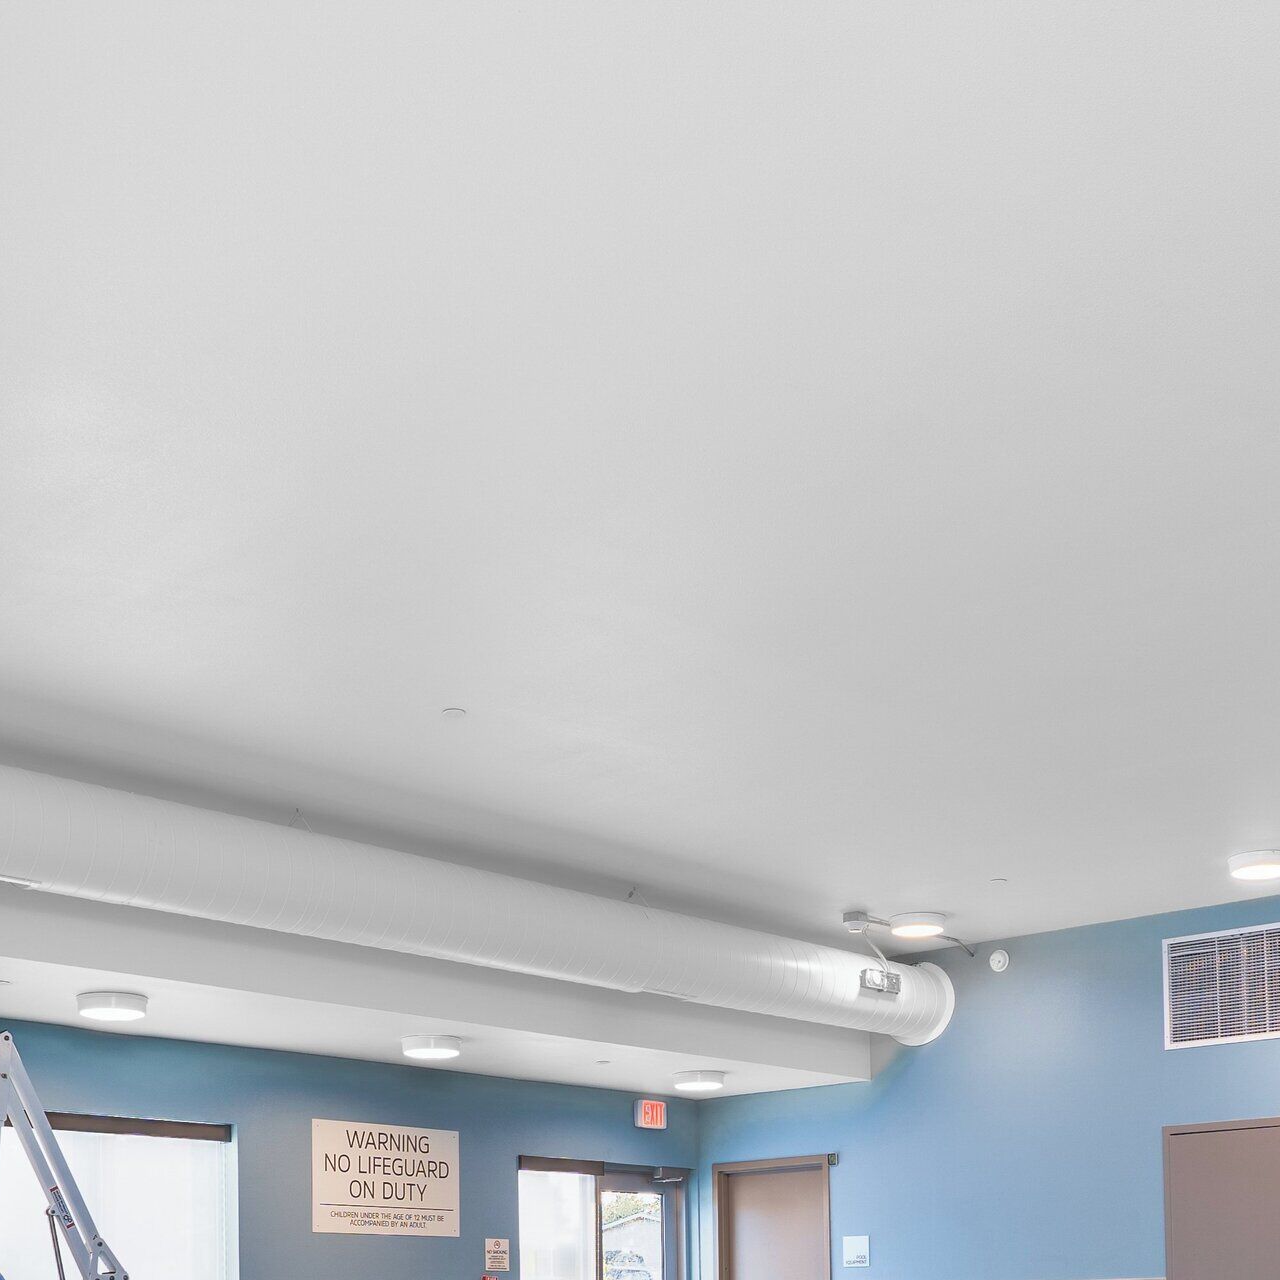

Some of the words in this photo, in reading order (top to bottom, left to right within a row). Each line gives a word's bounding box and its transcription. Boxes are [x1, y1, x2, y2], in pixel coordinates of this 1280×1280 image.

[644, 1103, 664, 1126] EXIT
[346, 1129, 430, 1154] WARNING
[324, 1153, 351, 1173] NO
[358, 1155, 449, 1179] LIFEGUARD
[349, 1179, 375, 1199] ON
[382, 1181, 428, 1202] DUTY
[330, 1210, 359, 1219] CHILDREN
[360, 1211, 380, 1220] UNDER
[381, 1212, 392, 1220] THE
[393, 1213, 404, 1221] AGE
[421, 1214, 436, 1222] MUST
[350, 1219, 390, 1227] ACCOMPANIED
[391, 1220, 399, 1228] BY
